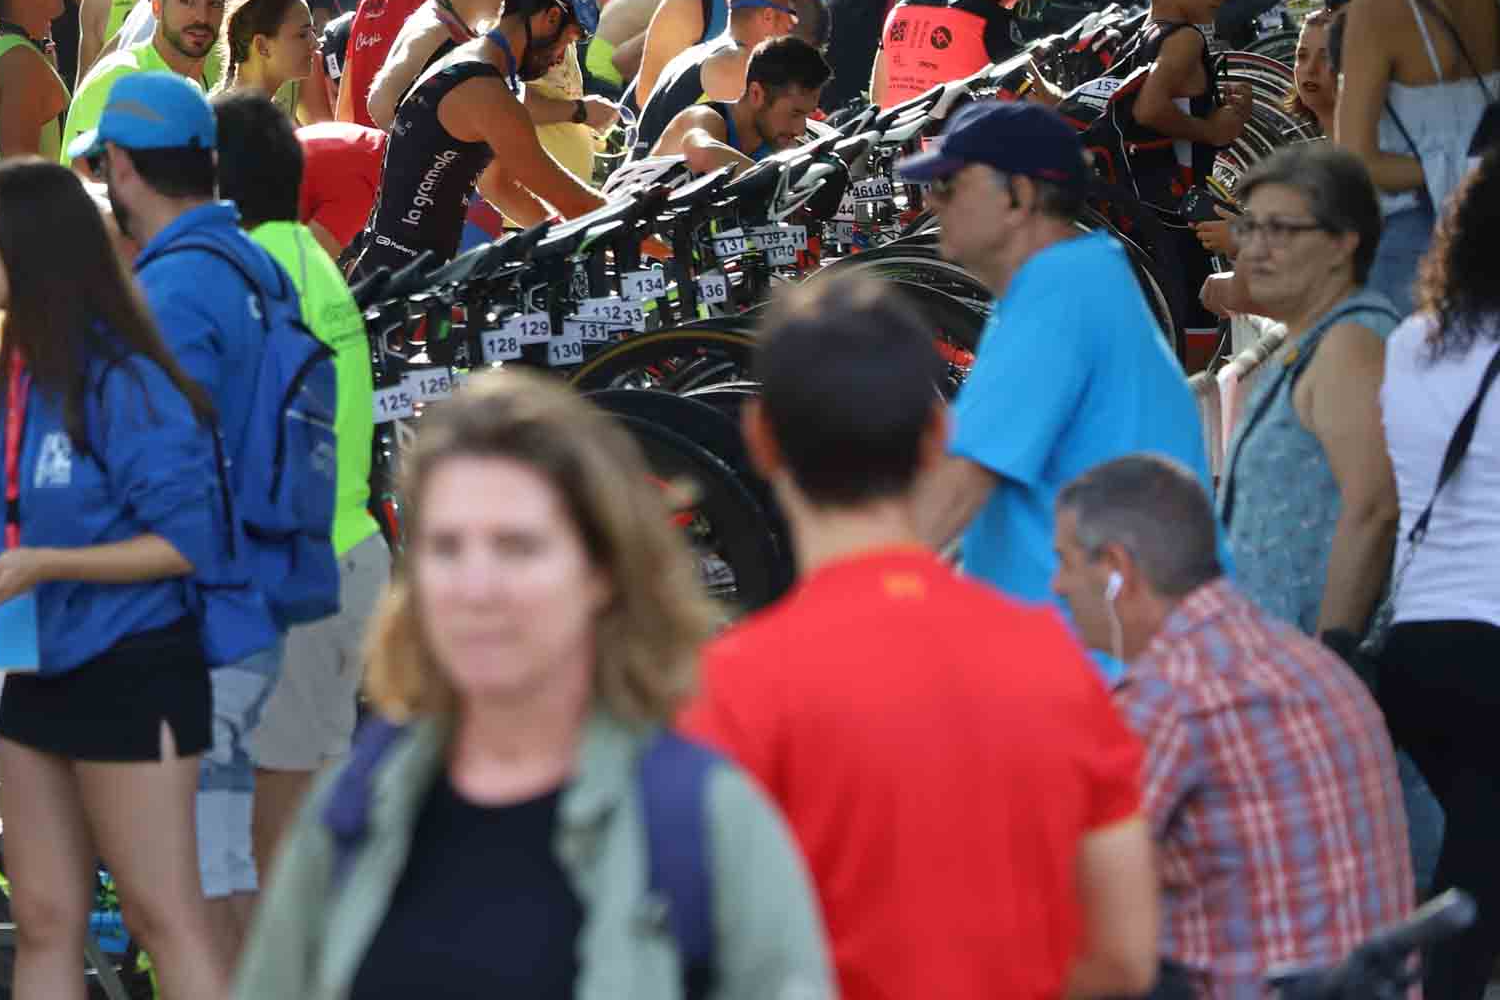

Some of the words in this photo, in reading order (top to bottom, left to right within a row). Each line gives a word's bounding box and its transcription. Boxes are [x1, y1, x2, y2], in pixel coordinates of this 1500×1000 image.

[412, 149, 460, 208] gramola
[636, 278, 663, 293] 134
[700, 283, 724, 299] 136
[592, 305, 621, 321] 132
[520, 320, 549, 338] 129
[579, 323, 607, 339] 131
[488, 337, 518, 355] 128
[552, 342, 582, 361] 130
[418, 376, 450, 396] 126
[378, 392, 411, 412] 125
